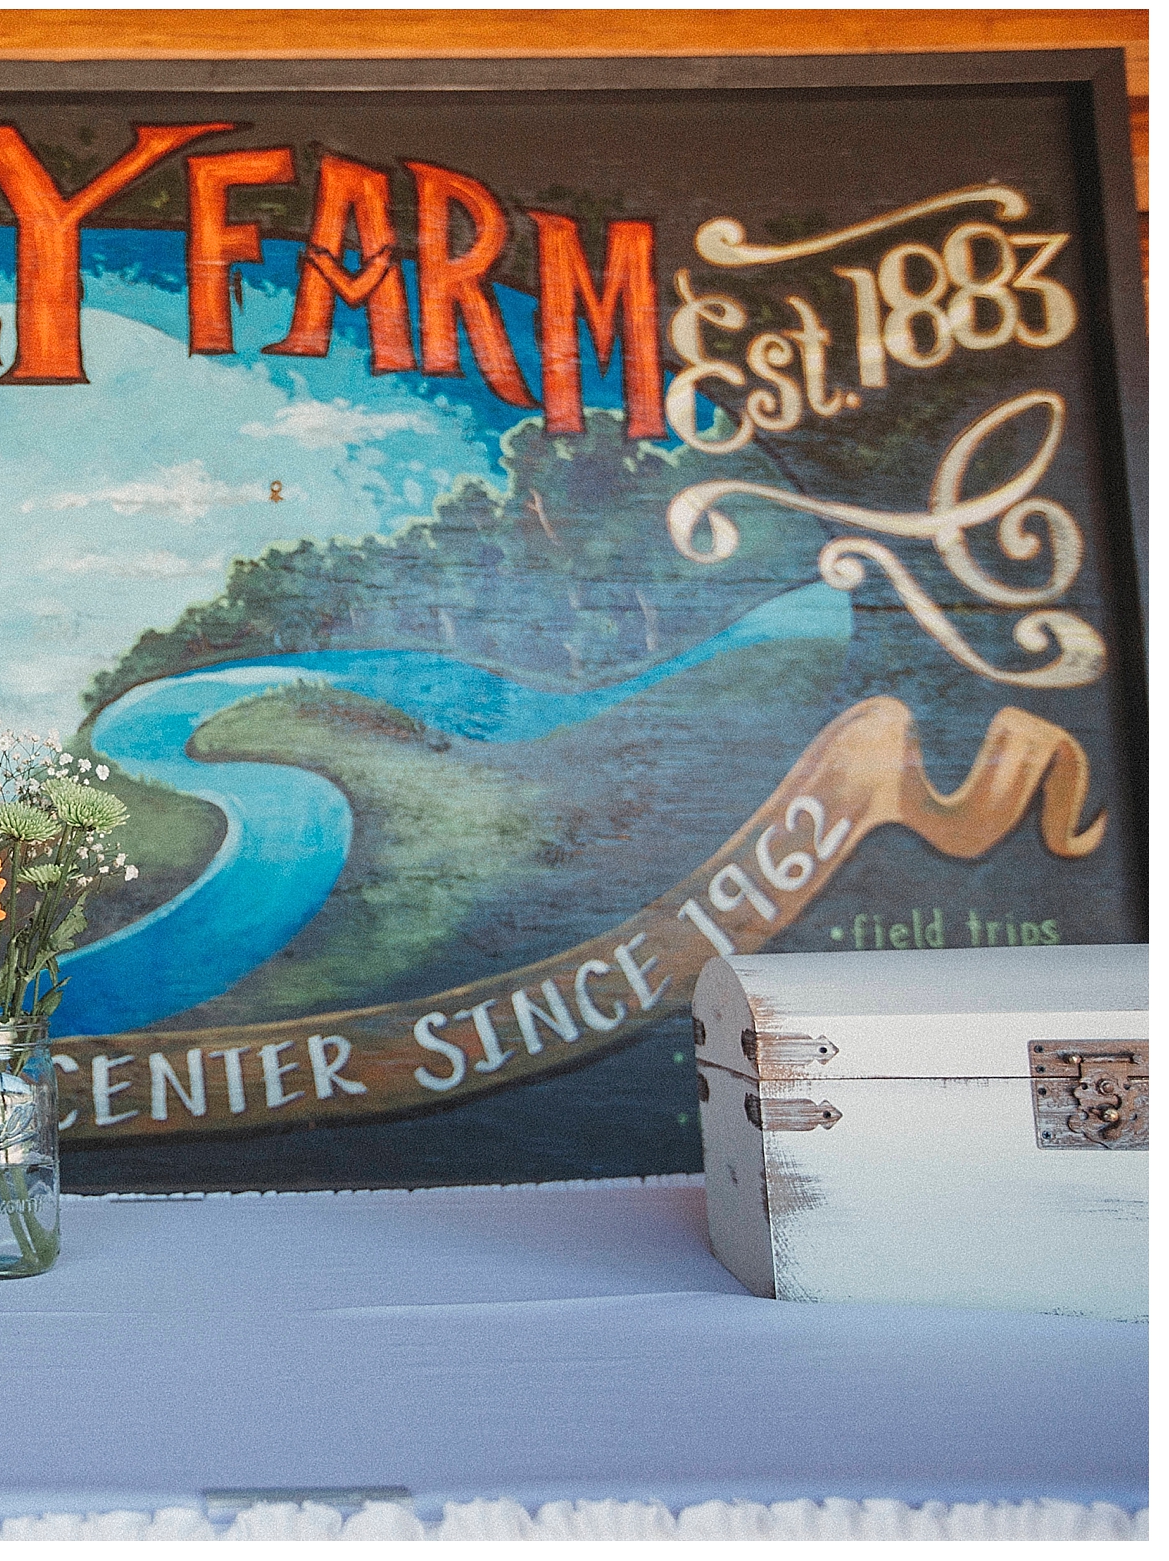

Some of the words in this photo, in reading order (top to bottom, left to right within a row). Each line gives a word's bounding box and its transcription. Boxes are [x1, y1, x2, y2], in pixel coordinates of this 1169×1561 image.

[186, 144, 669, 440] FARM
[666, 268, 860, 454] Est.
[835, 221, 1078, 389] 1883
[413, 931, 675, 1094] SINCE
[676, 793, 852, 956] 1962
[852, 907, 946, 950] field
[966, 908, 1061, 947] trips
